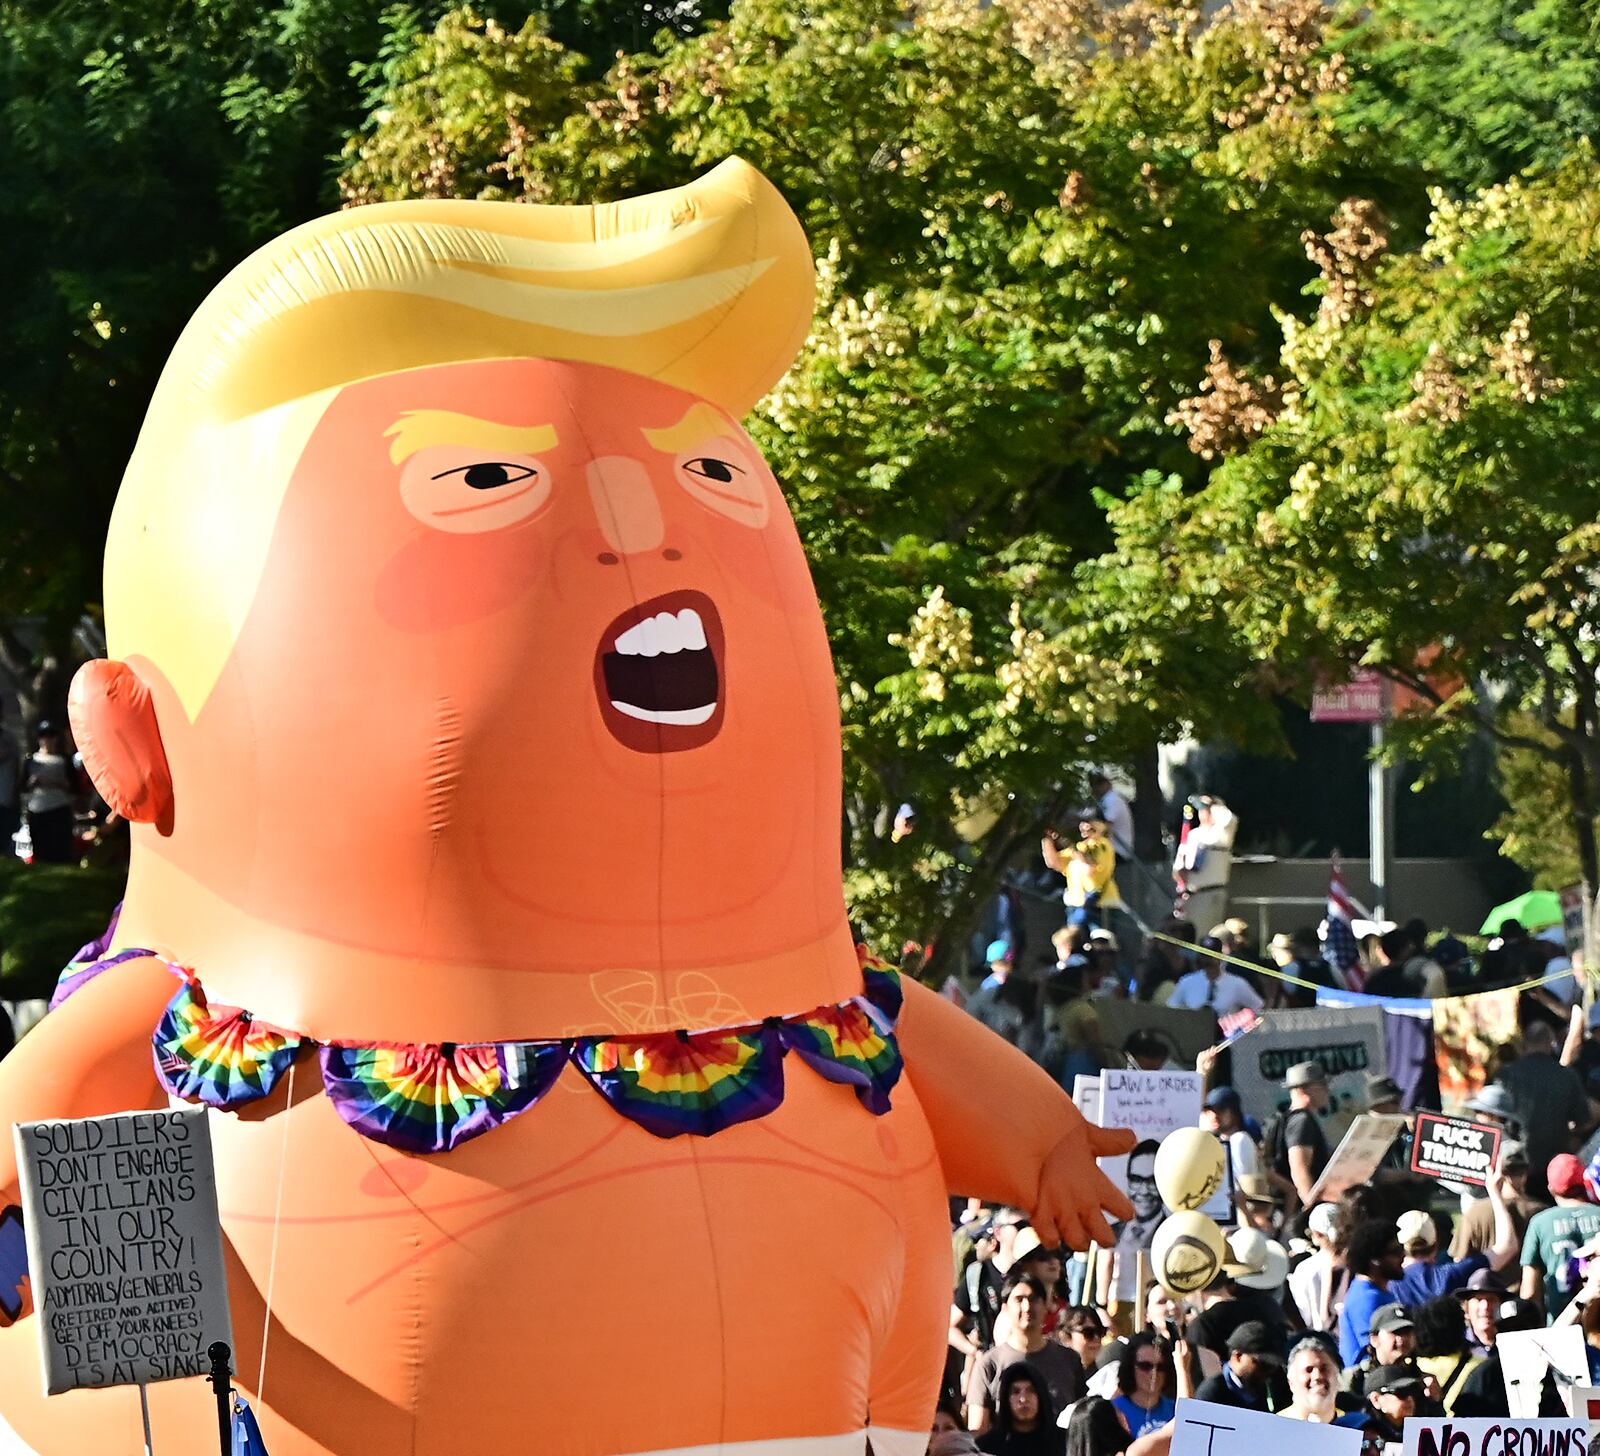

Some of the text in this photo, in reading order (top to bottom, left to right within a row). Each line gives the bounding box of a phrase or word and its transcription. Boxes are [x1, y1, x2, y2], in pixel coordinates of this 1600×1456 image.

[1107, 1074, 1143, 1092] LAW
[1158, 1076, 1198, 1093] ORDER
[33, 1110, 190, 1157] SOLDIERS
[1433, 1123, 1485, 1151] FUCK
[37, 1144, 196, 1188] DON'T ENGAGE
[1421, 1140, 1491, 1170] TRUMP
[42, 1174, 196, 1218] CIVILIANS
[57, 1206, 181, 1249] IN OUR
[42, 1270, 203, 1311] ADMIRALS/GENERALS
[51, 1295, 197, 1331] (RETIRED AND ACTIVE)
[54, 1323, 84, 1346] GET
[87, 1320, 113, 1342] OFF
[116, 1317, 151, 1338] YOUR
[64, 1331, 203, 1369] DEMOCRACY
[68, 1351, 209, 1387] IS AT STAKE
